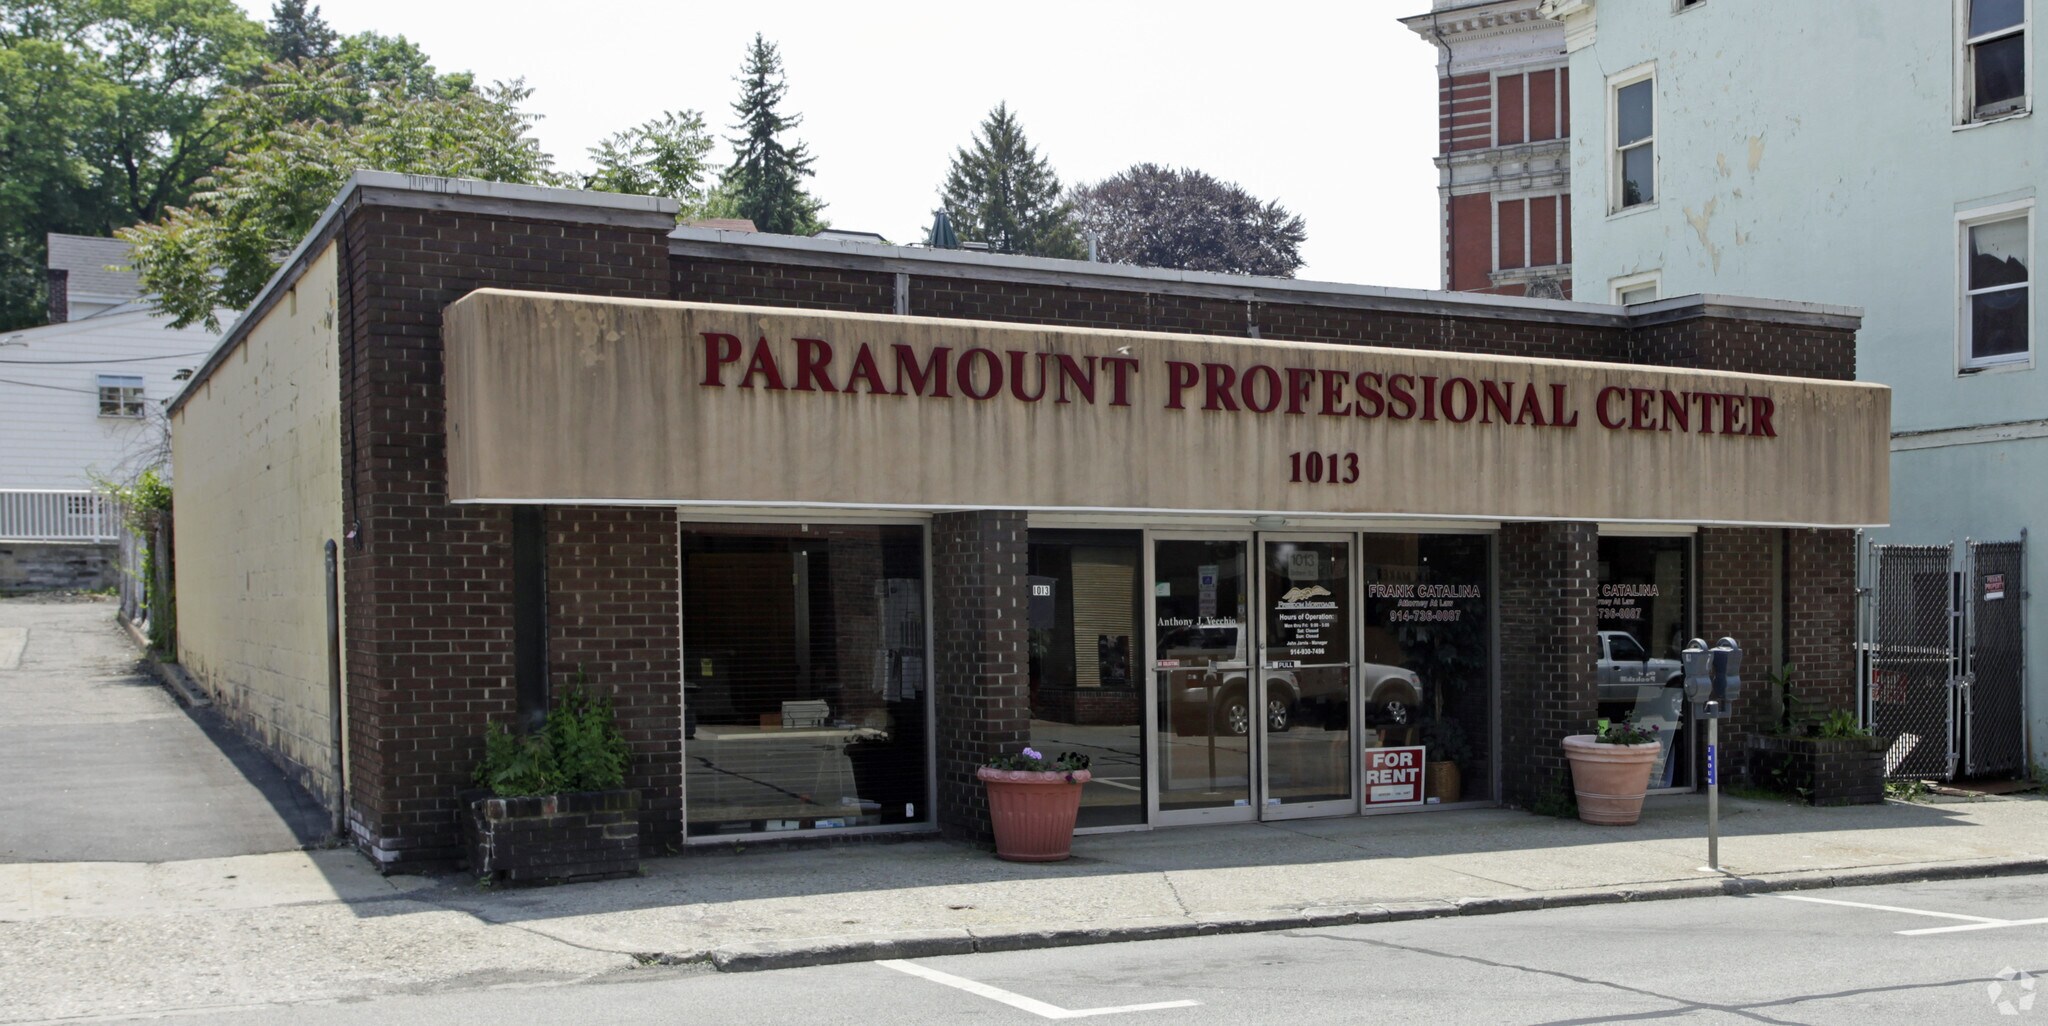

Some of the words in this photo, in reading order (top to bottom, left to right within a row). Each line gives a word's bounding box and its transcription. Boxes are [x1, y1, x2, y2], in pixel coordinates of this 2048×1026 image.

[700, 332, 1139, 406] PARAMOUNT
[1164, 360, 1579, 427] PROFESSIONAL
[1597, 386, 1778, 437] CENTER
[1289, 451, 1360, 484] 1013
[1291, 554, 1315, 567] 1013
[1033, 585, 1050, 596] 1013
[1368, 584, 1415, 598] FRANK
[1417, 584, 1480, 598] CATALINA
[1602, 584, 1659, 597] CATALINA
[1397, 599, 1428, 608] Attorney
[1429, 599, 1438, 607] At
[1439, 599, 1454, 607] Law
[1157, 617, 1193, 627] Anthony
[1196, 616, 1204, 626] J.
[1206, 616, 1237, 625] Vecchio
[1305, 613, 1334, 621] Operation:
[1373, 752, 1413, 768] FOR
[1366, 768, 1419, 784] RENT
